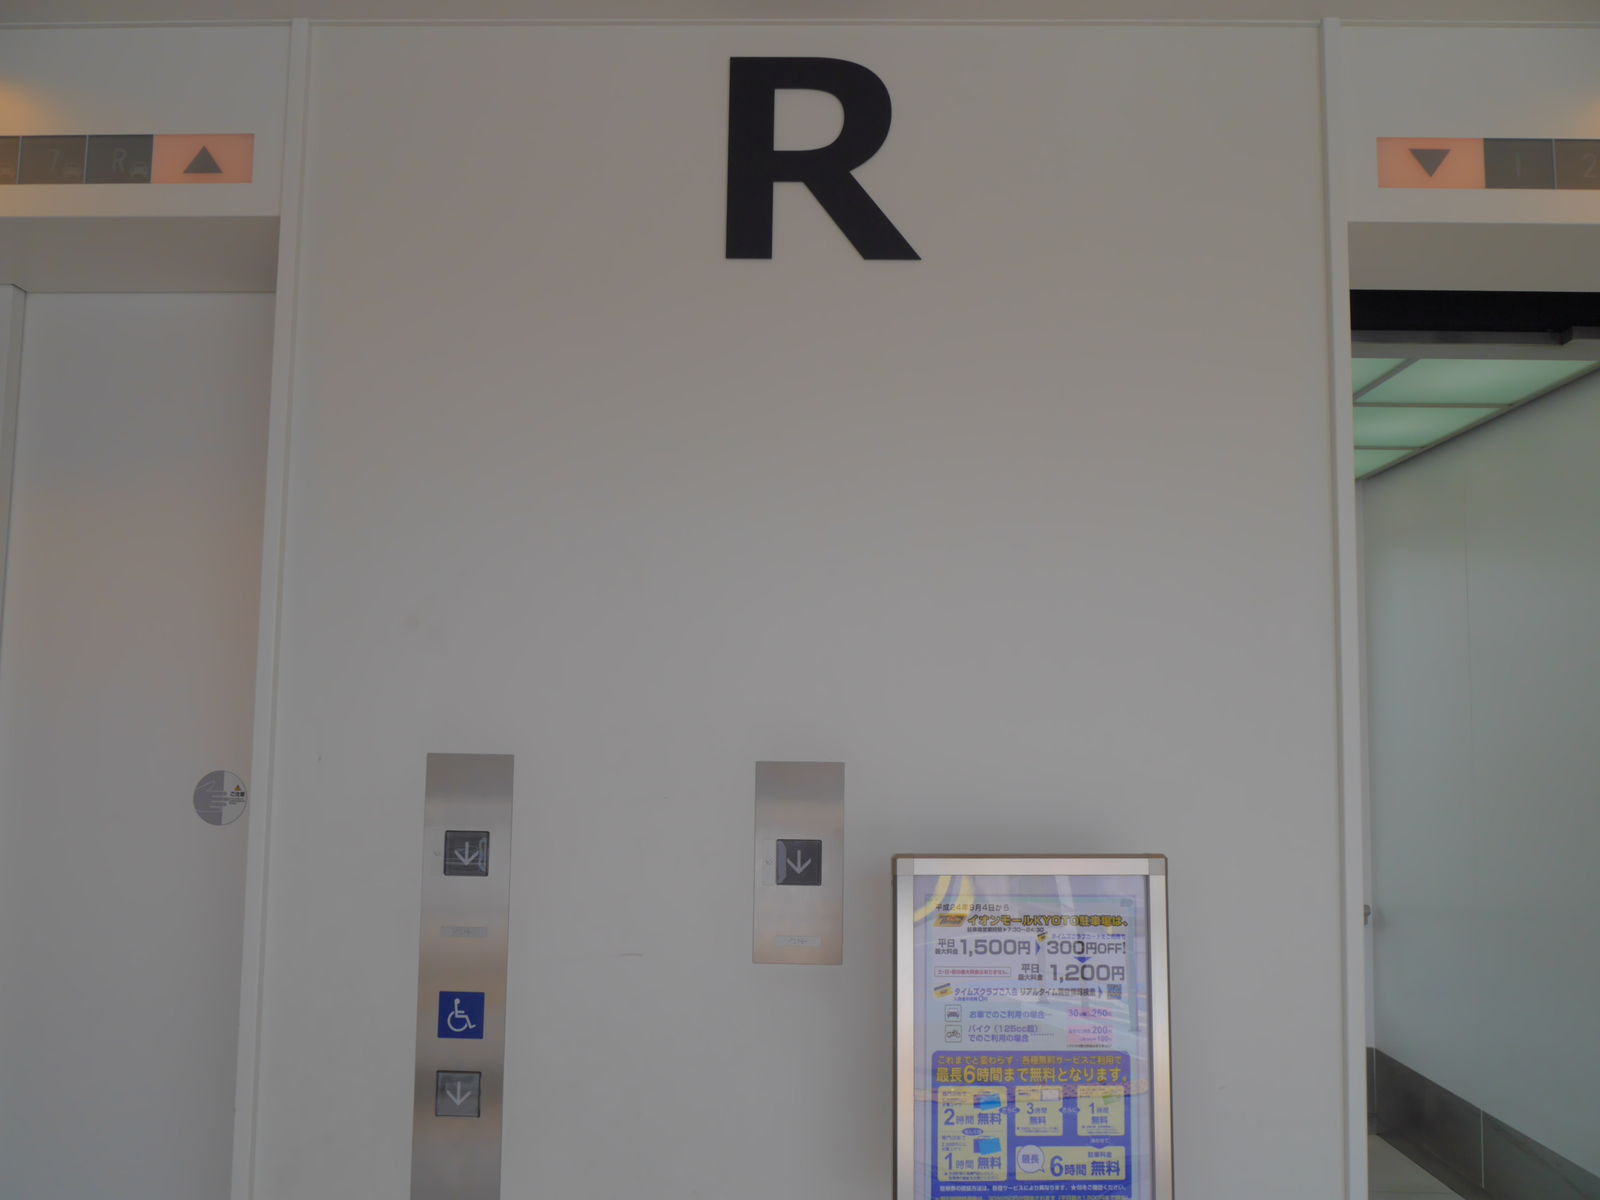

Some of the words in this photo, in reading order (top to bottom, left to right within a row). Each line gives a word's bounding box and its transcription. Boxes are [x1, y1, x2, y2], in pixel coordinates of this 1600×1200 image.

[112, 148, 127, 173] R
[726, 57, 921, 260] R
[935, 903, 1010, 912] 平成24年9月4日から
[938, 938, 955, 948] 平日
[960, 939, 1031, 957] 1,500円
[1021, 963, 1040, 974] 平日
[1050, 964, 1125, 983] 1,200円
[968, 1034, 1030, 1043] でのご利用の場合
[936, 1065, 1127, 1084] 最長6時間まで無料となります。
[976, 1112, 1002, 1125] 無料
[976, 1156, 1002, 1170] 無料
[1050, 1155, 1087, 1177] 6時間
[1090, 1160, 1121, 1176] 無料
